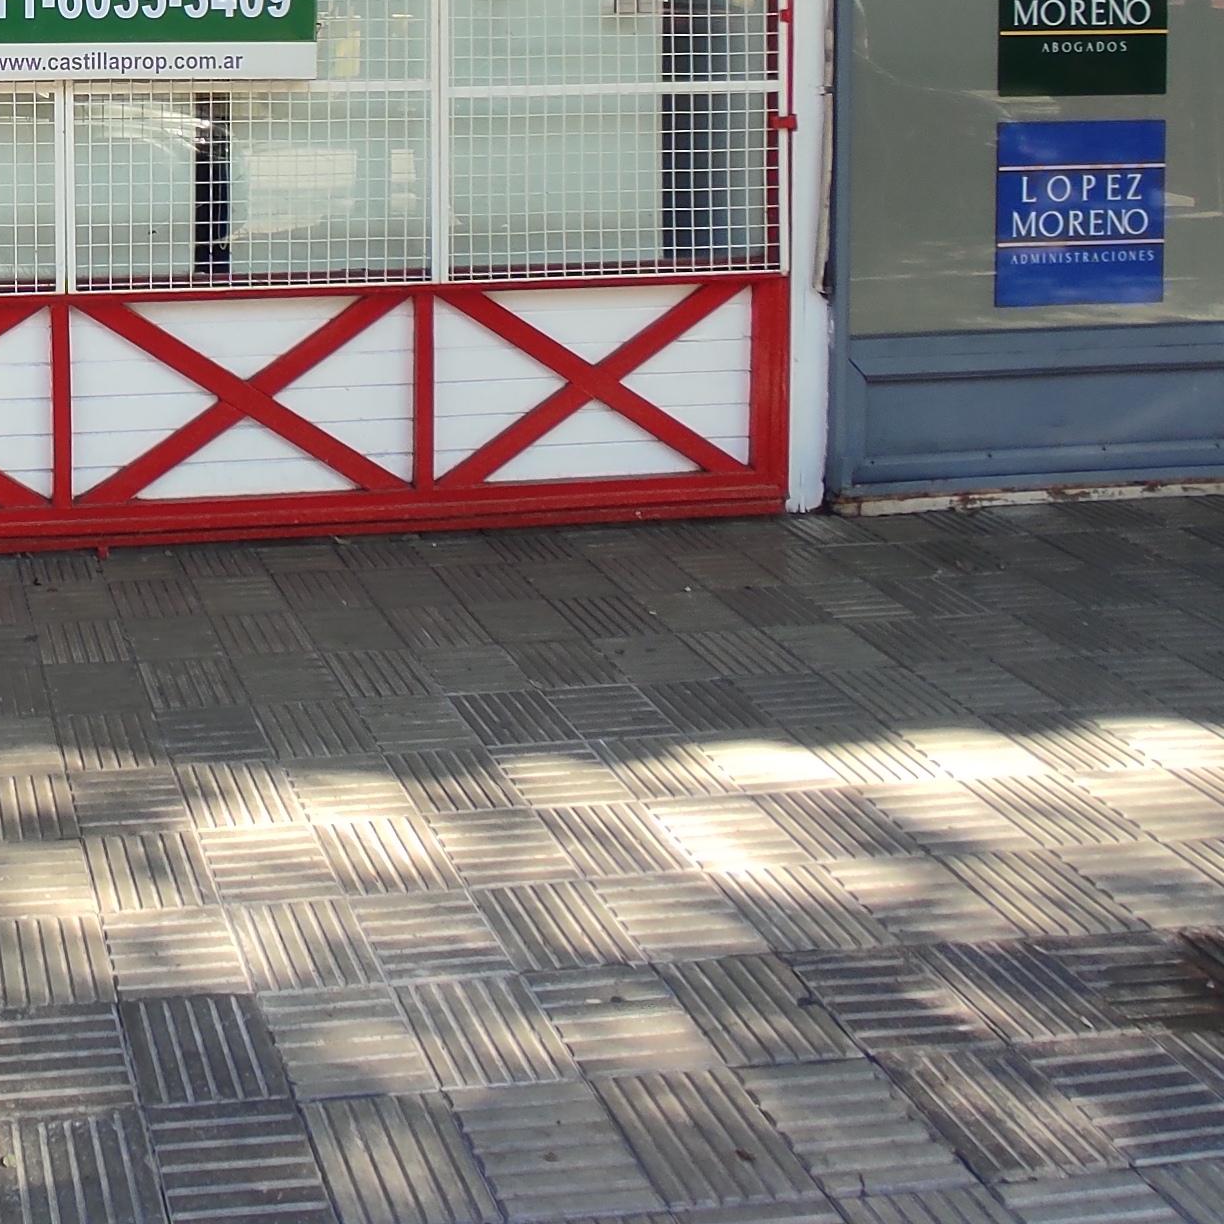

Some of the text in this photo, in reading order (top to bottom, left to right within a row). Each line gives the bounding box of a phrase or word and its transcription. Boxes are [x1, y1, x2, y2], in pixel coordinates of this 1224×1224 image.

[1041, 40, 1129, 54] ABOGADOS
[1021, 173, 1143, 204] LOPEZ
[1011, 208, 1150, 238] MORENO
[1010, 249, 1156, 265] ADMINISTRACIONES
